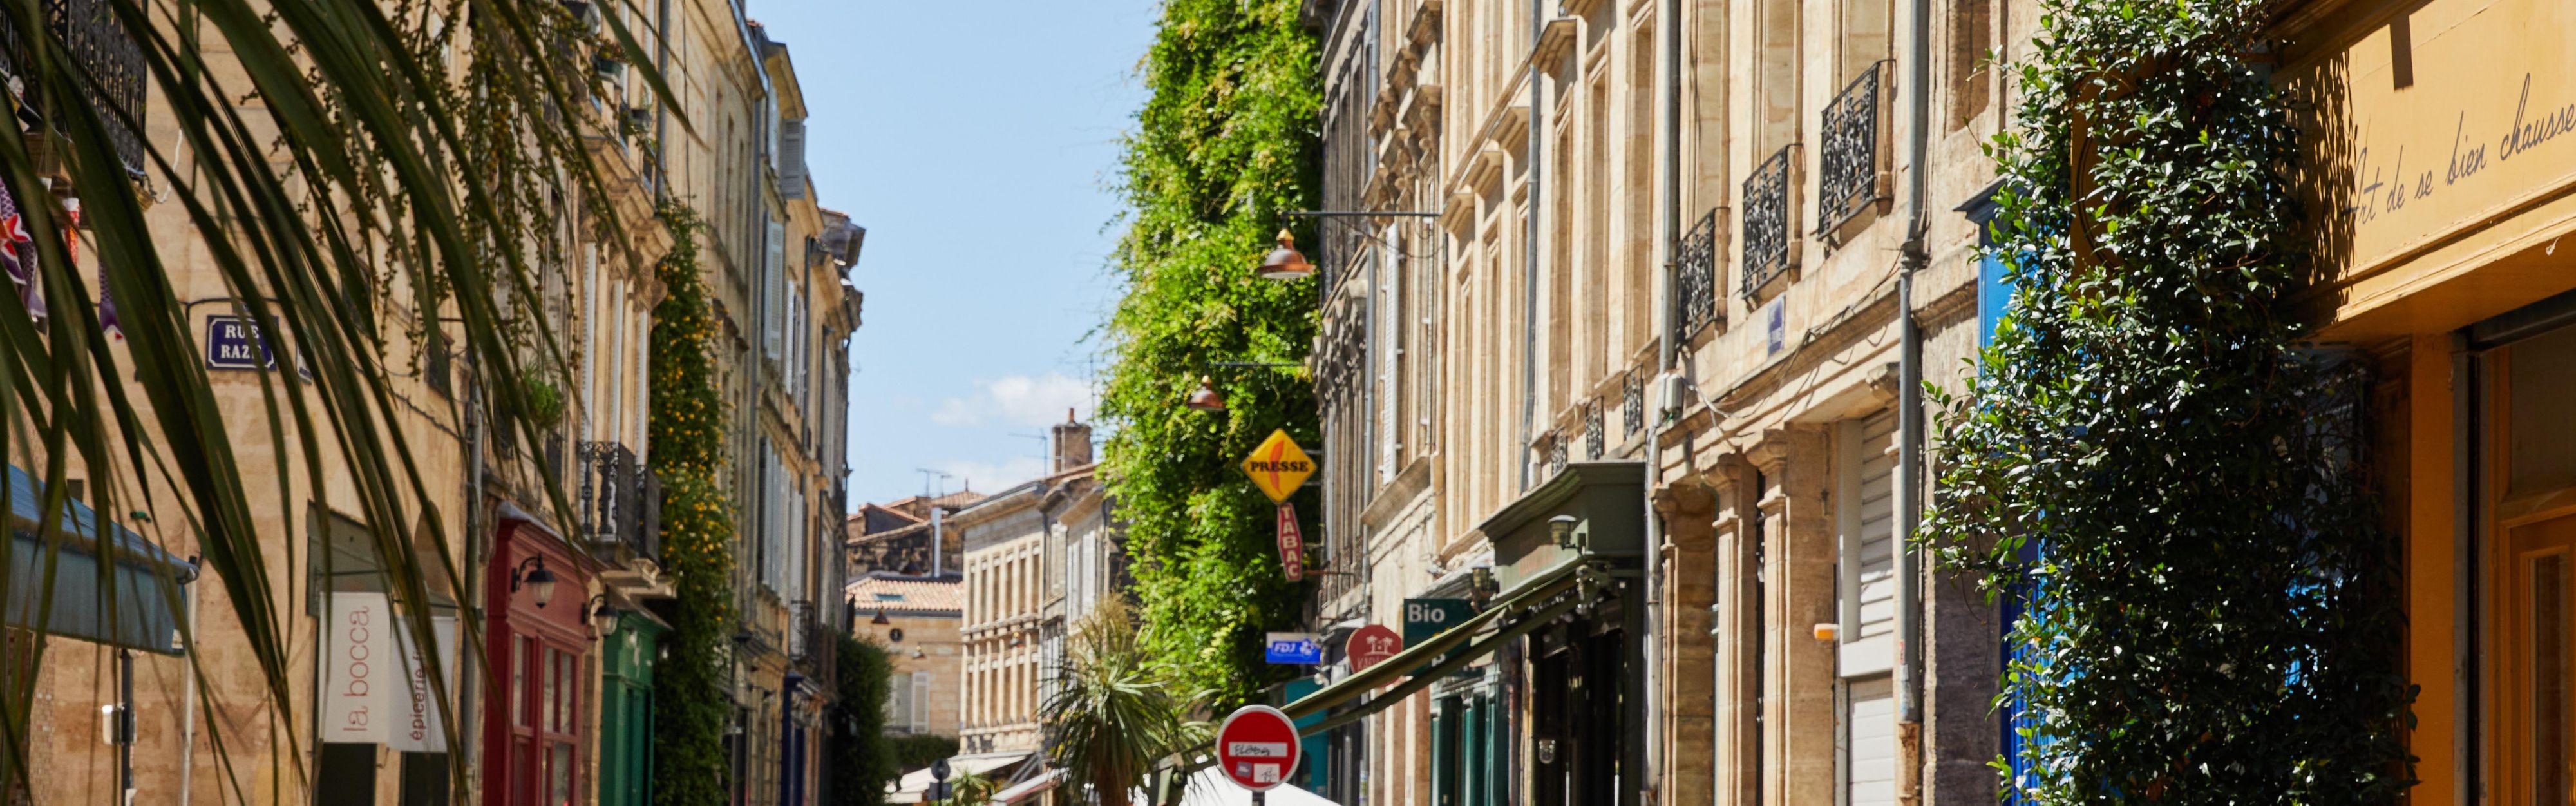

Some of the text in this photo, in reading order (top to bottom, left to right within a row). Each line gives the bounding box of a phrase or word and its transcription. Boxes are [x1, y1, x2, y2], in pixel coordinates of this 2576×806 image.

[2387, 144, 2405, 214] de
[2414, 170, 2433, 200] se
[2445, 110, 2487, 186] bien
[225, 324, 260, 339] RUE
[220, 344, 261, 359] RAZ
[1250, 461, 1309, 472] PRESSE
[1281, 506, 1298, 578] TABAC
[1408, 603, 1445, 623] Bio
[1274, 642, 1296, 653] FDJ
[343, 606, 370, 732] la bocca
[409, 668, 426, 741] épicerie
